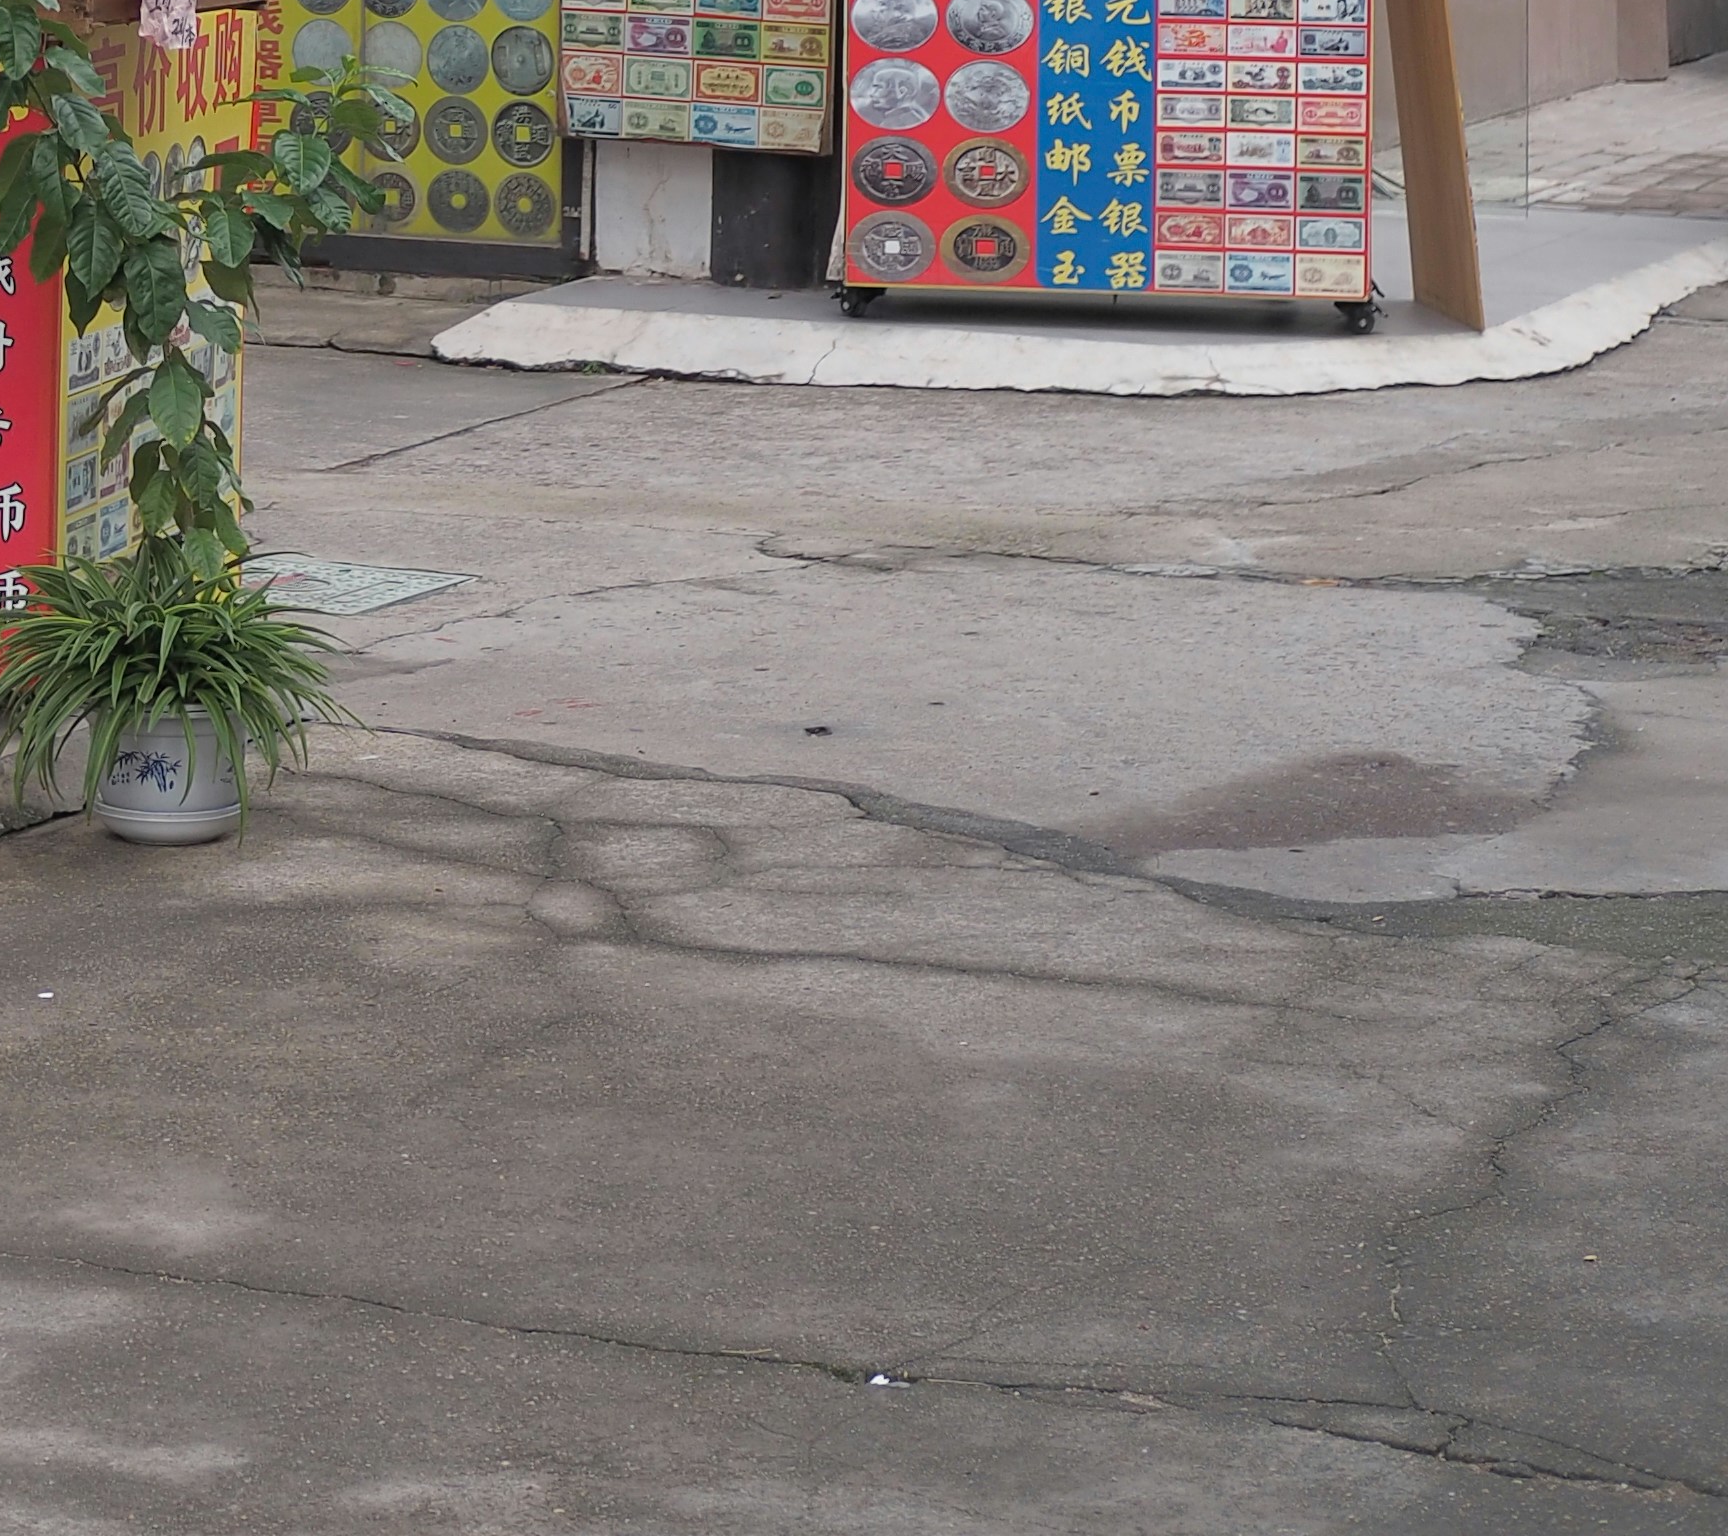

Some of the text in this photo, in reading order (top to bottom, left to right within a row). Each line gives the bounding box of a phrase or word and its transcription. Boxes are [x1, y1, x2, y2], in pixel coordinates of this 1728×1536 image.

[1041, 38, 1152, 82] 铜钱
[1046, 89, 1141, 134] 纸币
[1044, 140, 1148, 186] 邮票
[1040, 195, 1150, 237] 金银
[1050, 251, 1148, 291] 玉器
